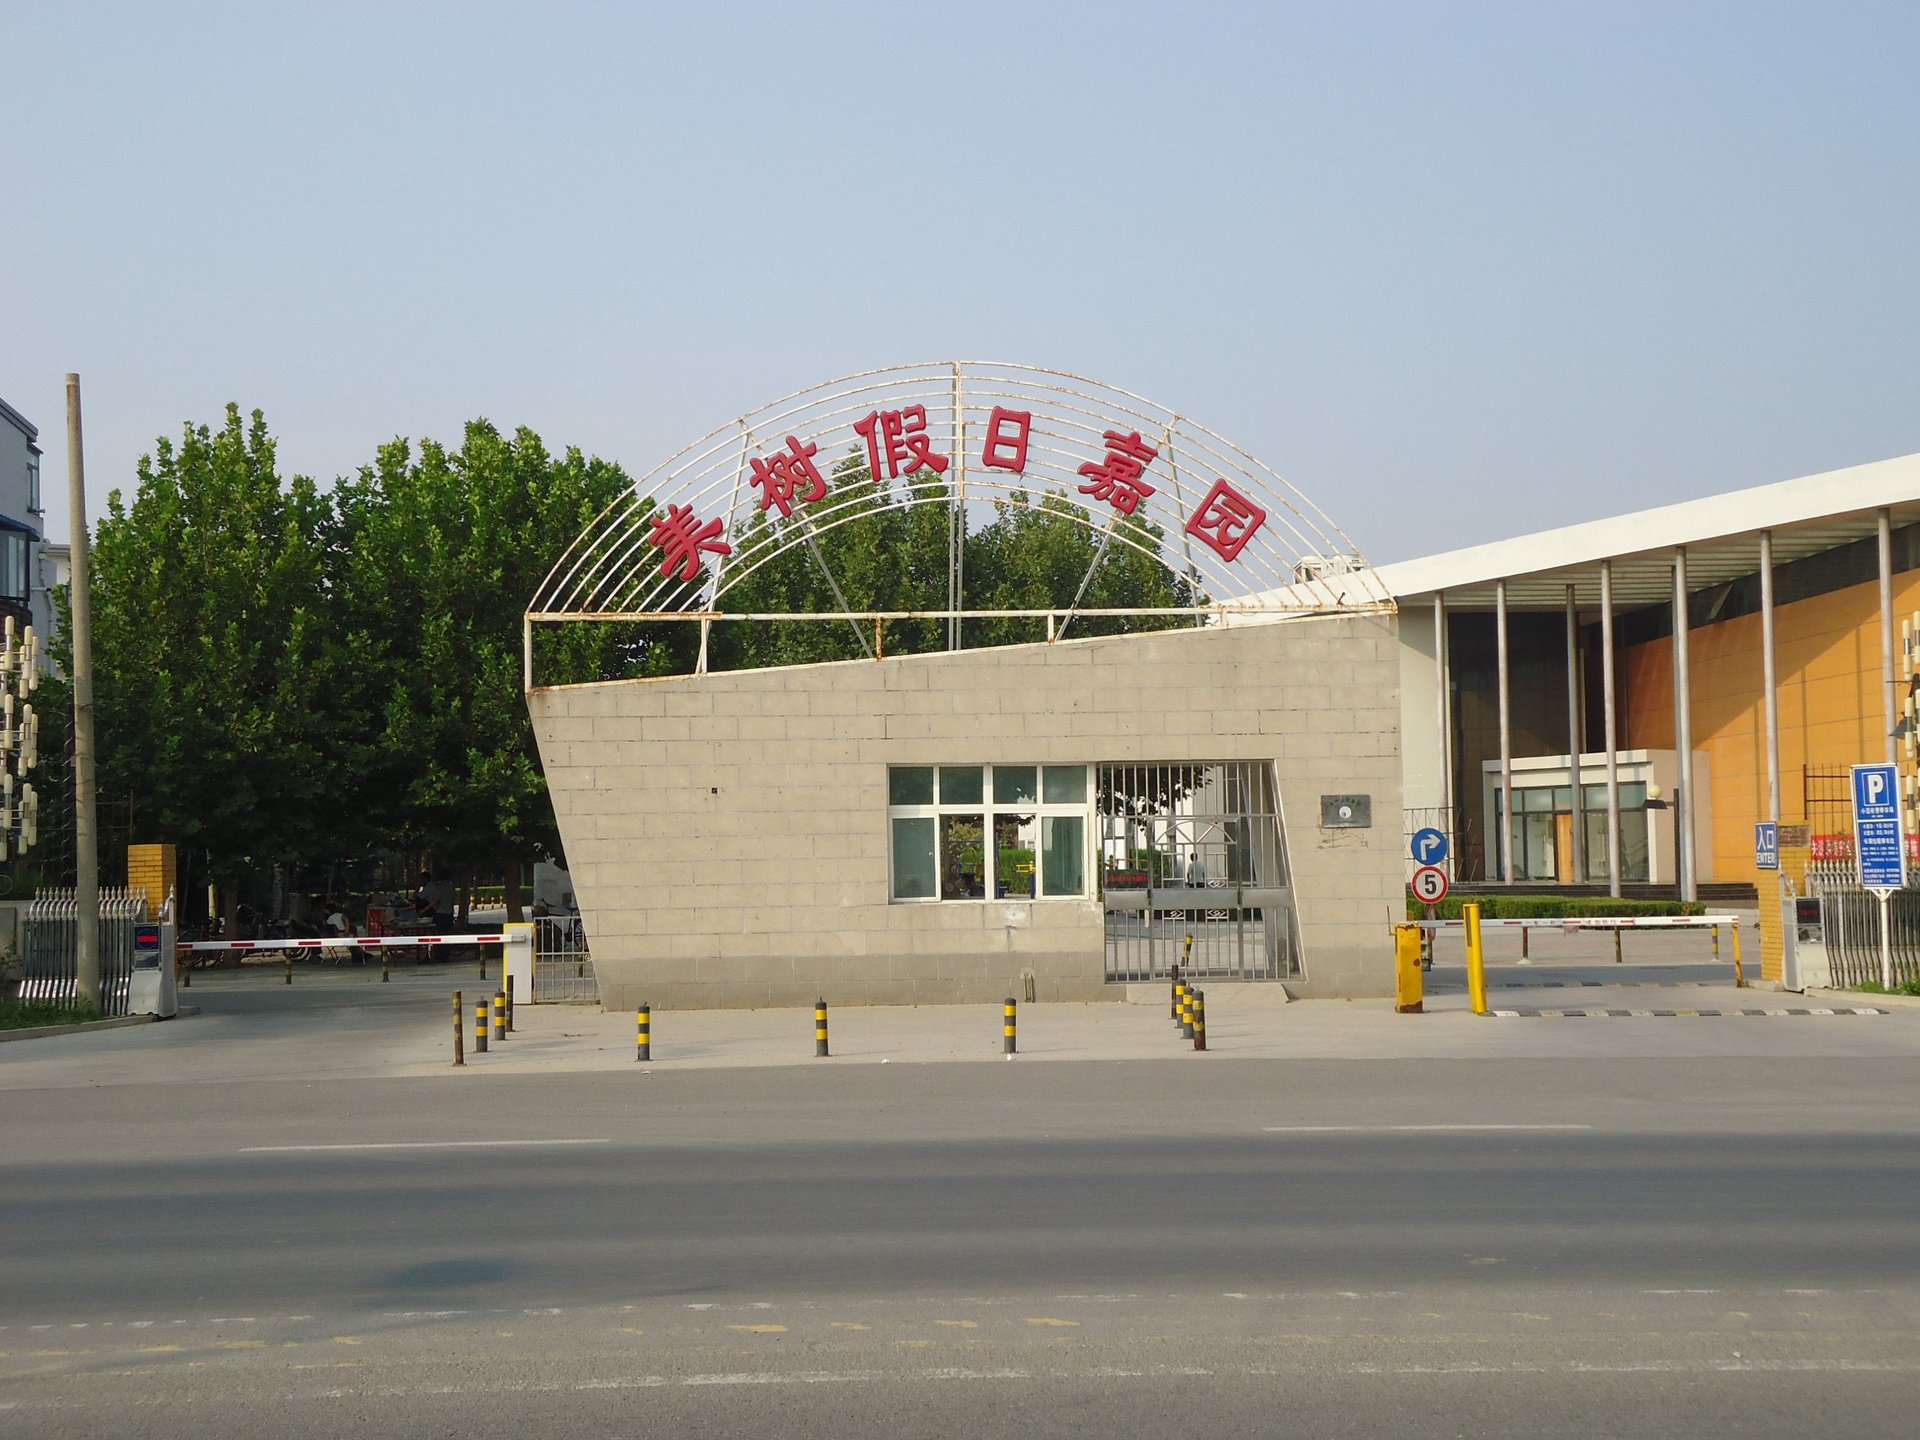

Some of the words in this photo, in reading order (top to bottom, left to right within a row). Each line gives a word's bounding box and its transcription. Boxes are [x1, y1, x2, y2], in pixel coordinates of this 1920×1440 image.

[648, 403, 1266, 581] 美树假日嘉园
[1867, 774, 1883, 804] P
[1757, 826, 1775, 851] 入口
[1756, 852, 1776, 864] ENTER
[1424, 874, 1437, 895] 5
